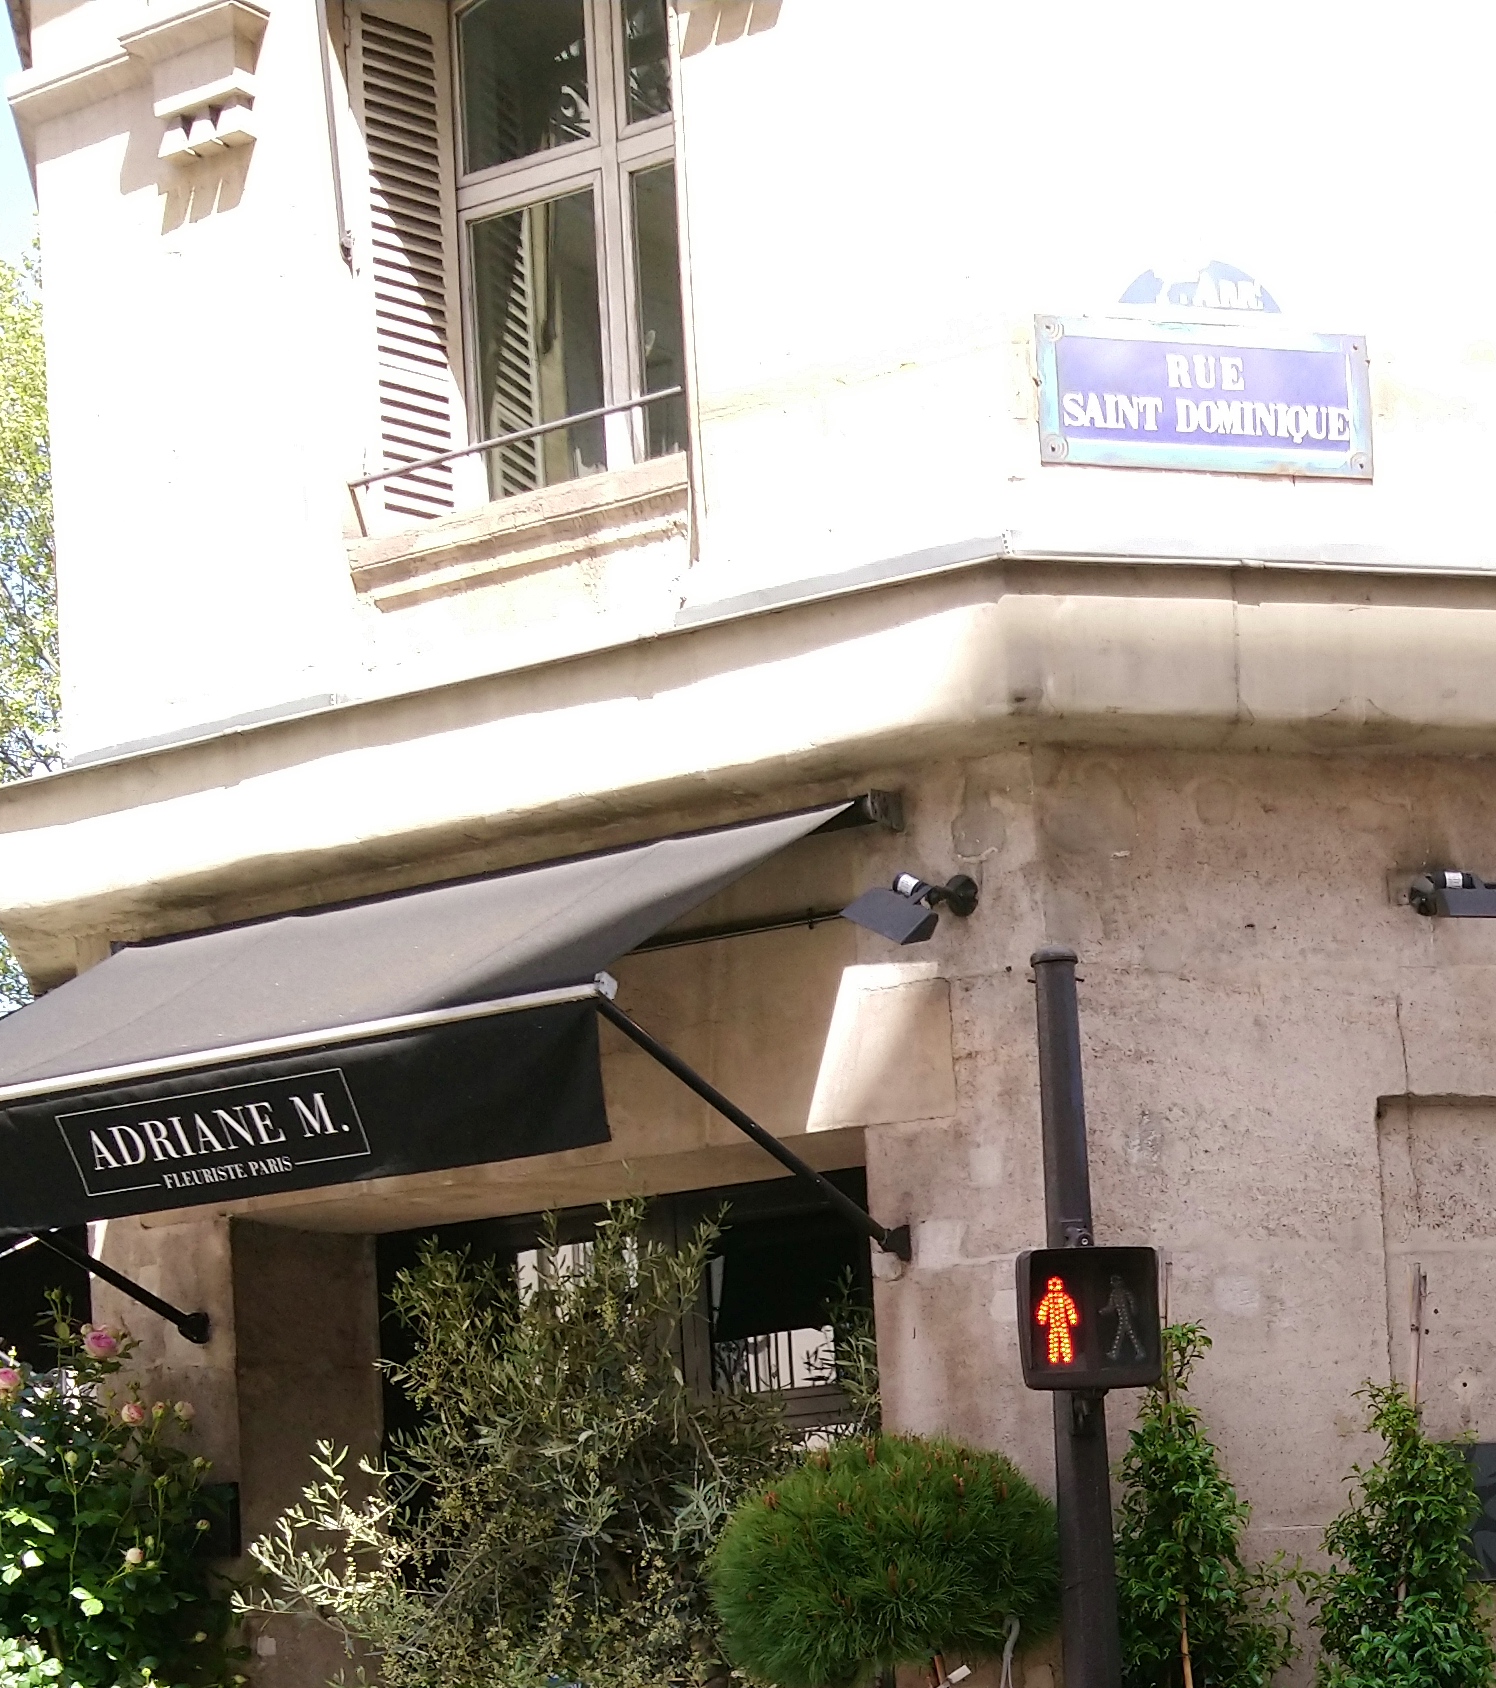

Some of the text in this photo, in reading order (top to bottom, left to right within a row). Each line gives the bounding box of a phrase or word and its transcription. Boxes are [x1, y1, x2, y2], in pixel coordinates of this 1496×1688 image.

[1166, 354, 1245, 391] RUE
[1062, 391, 1351, 444] SAINT DOMINIQUE
[88, 1091, 352, 1172] ADRIANE M.
[163, 1157, 292, 1188] FLEURISTE PARIS
